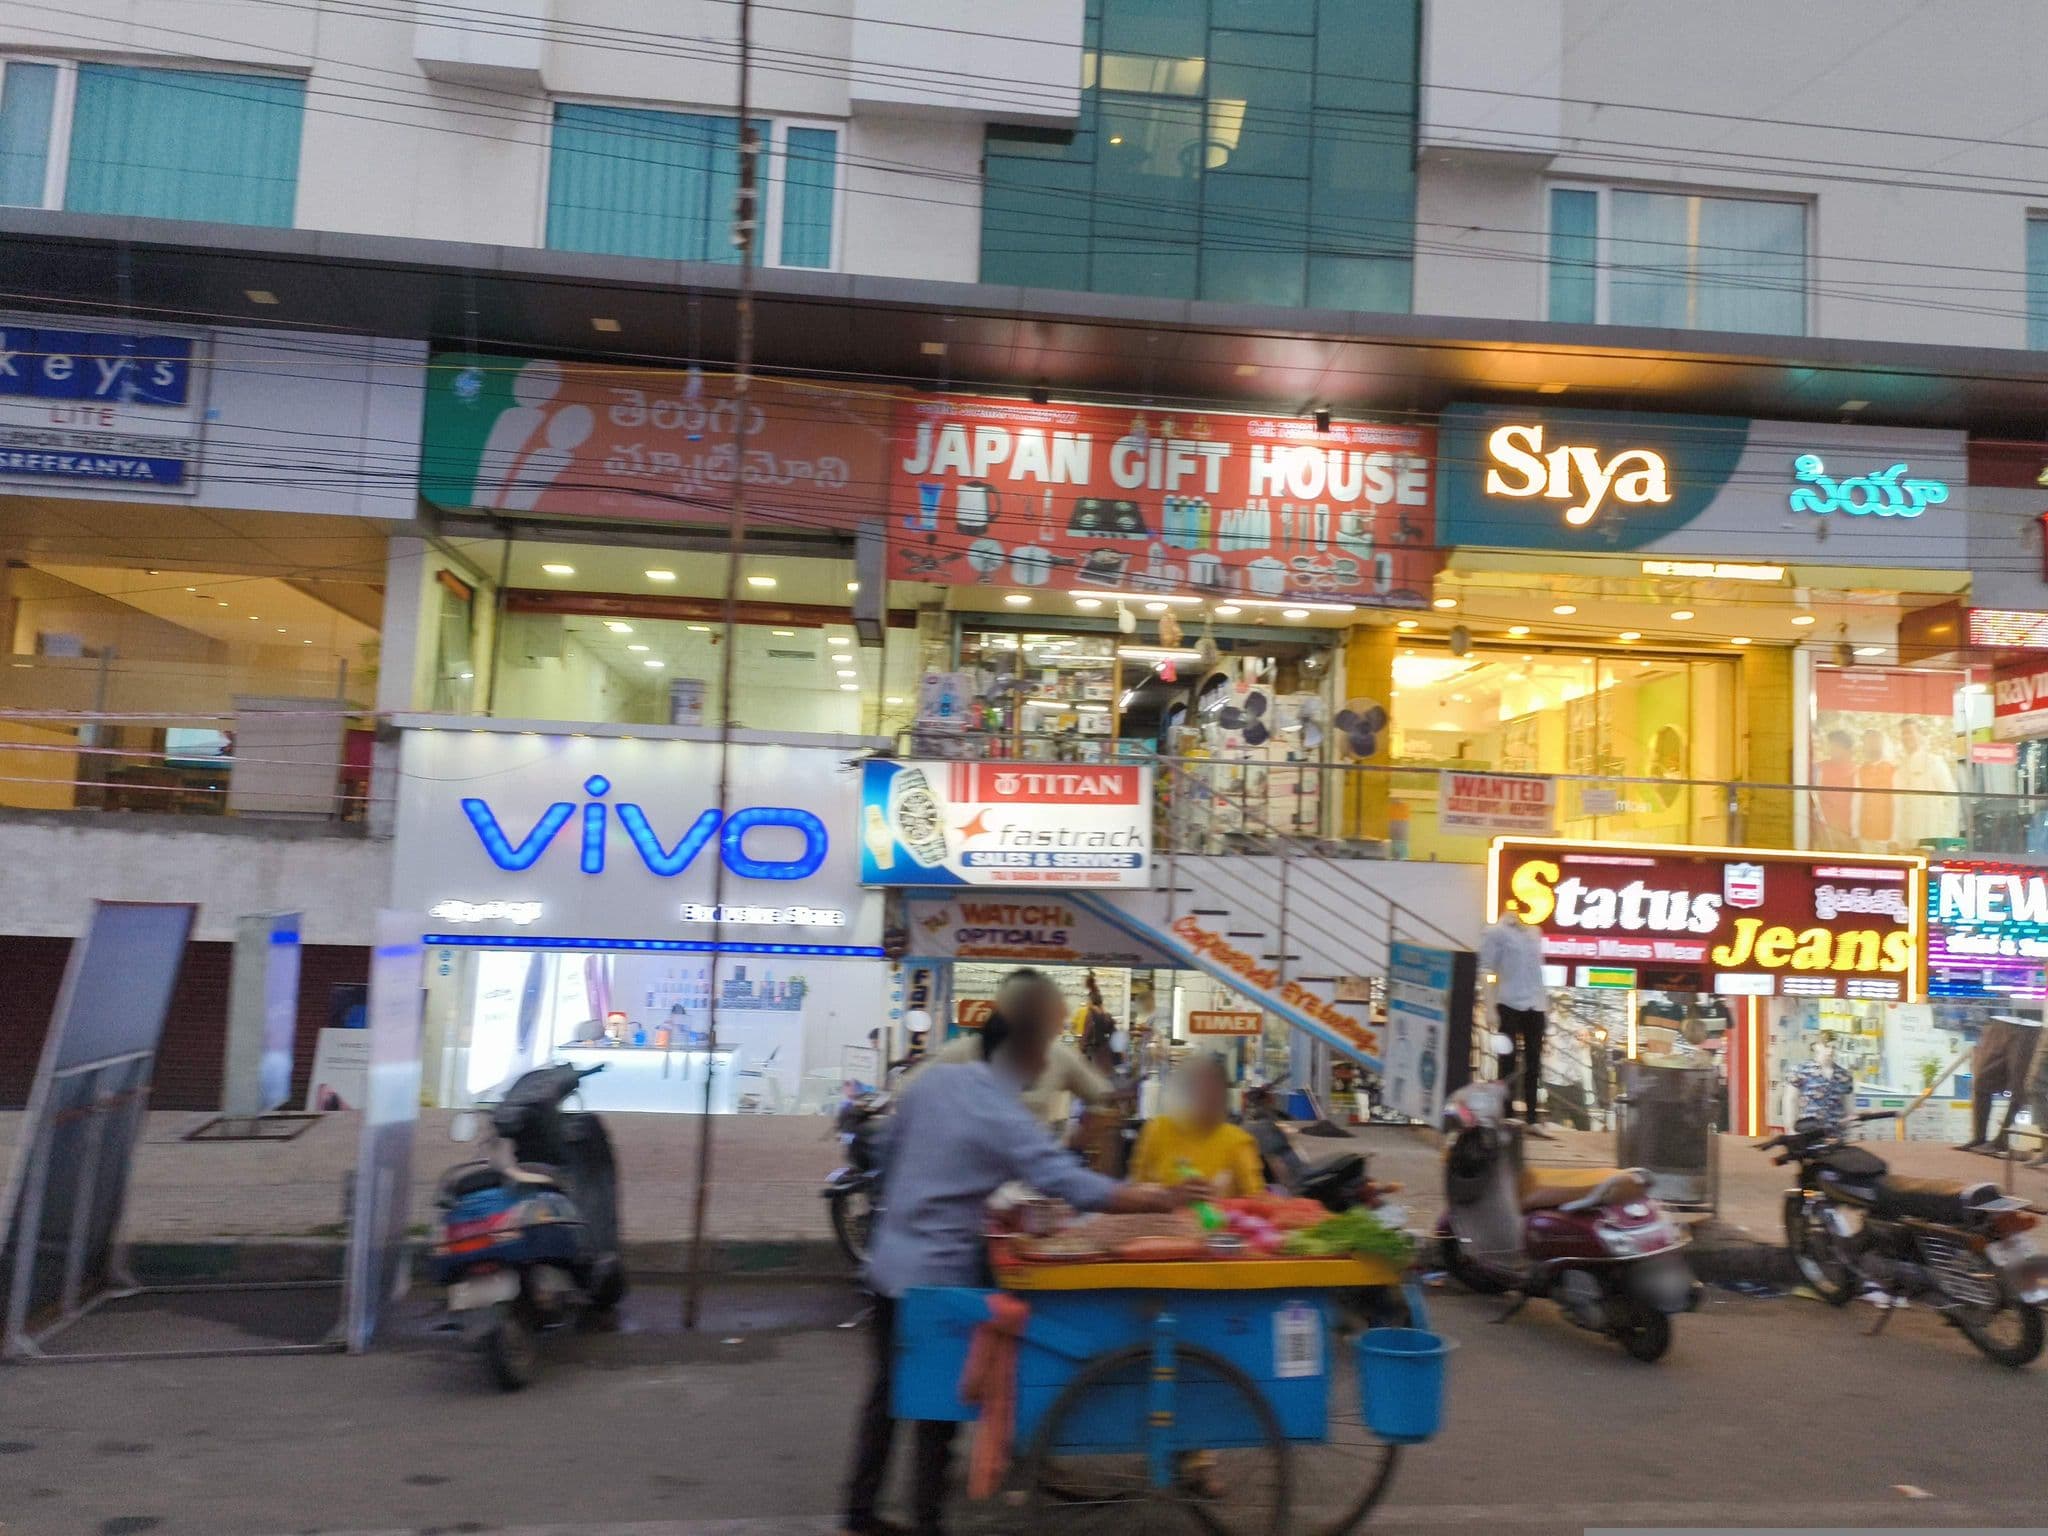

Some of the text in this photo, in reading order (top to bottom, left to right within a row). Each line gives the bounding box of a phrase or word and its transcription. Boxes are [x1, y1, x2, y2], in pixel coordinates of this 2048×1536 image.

[0, 331, 175, 395] keys
[51, 404, 115, 427] LITE
[902, 421, 1428, 506] JAPAN GIFT HOUSE
[1485, 424, 1672, 526] Siya
[1022, 774, 1123, 796] TITAN
[1453, 775, 1545, 802] WANTED
[460, 773, 829, 880] vivo
[999, 823, 1145, 848] fastrack
[970, 853, 1033, 867] SALES
[1051, 854, 1135, 868] SERVICE
[1507, 859, 1723, 934] Status
[1939, 872, 2048, 923] NEW
[960, 903, 1062, 926] WATCH
[955, 927, 1068, 946] OPTICALS
[1711, 918, 1917, 972] Jeans
[1192, 1014, 1259, 1032] TIMEX
